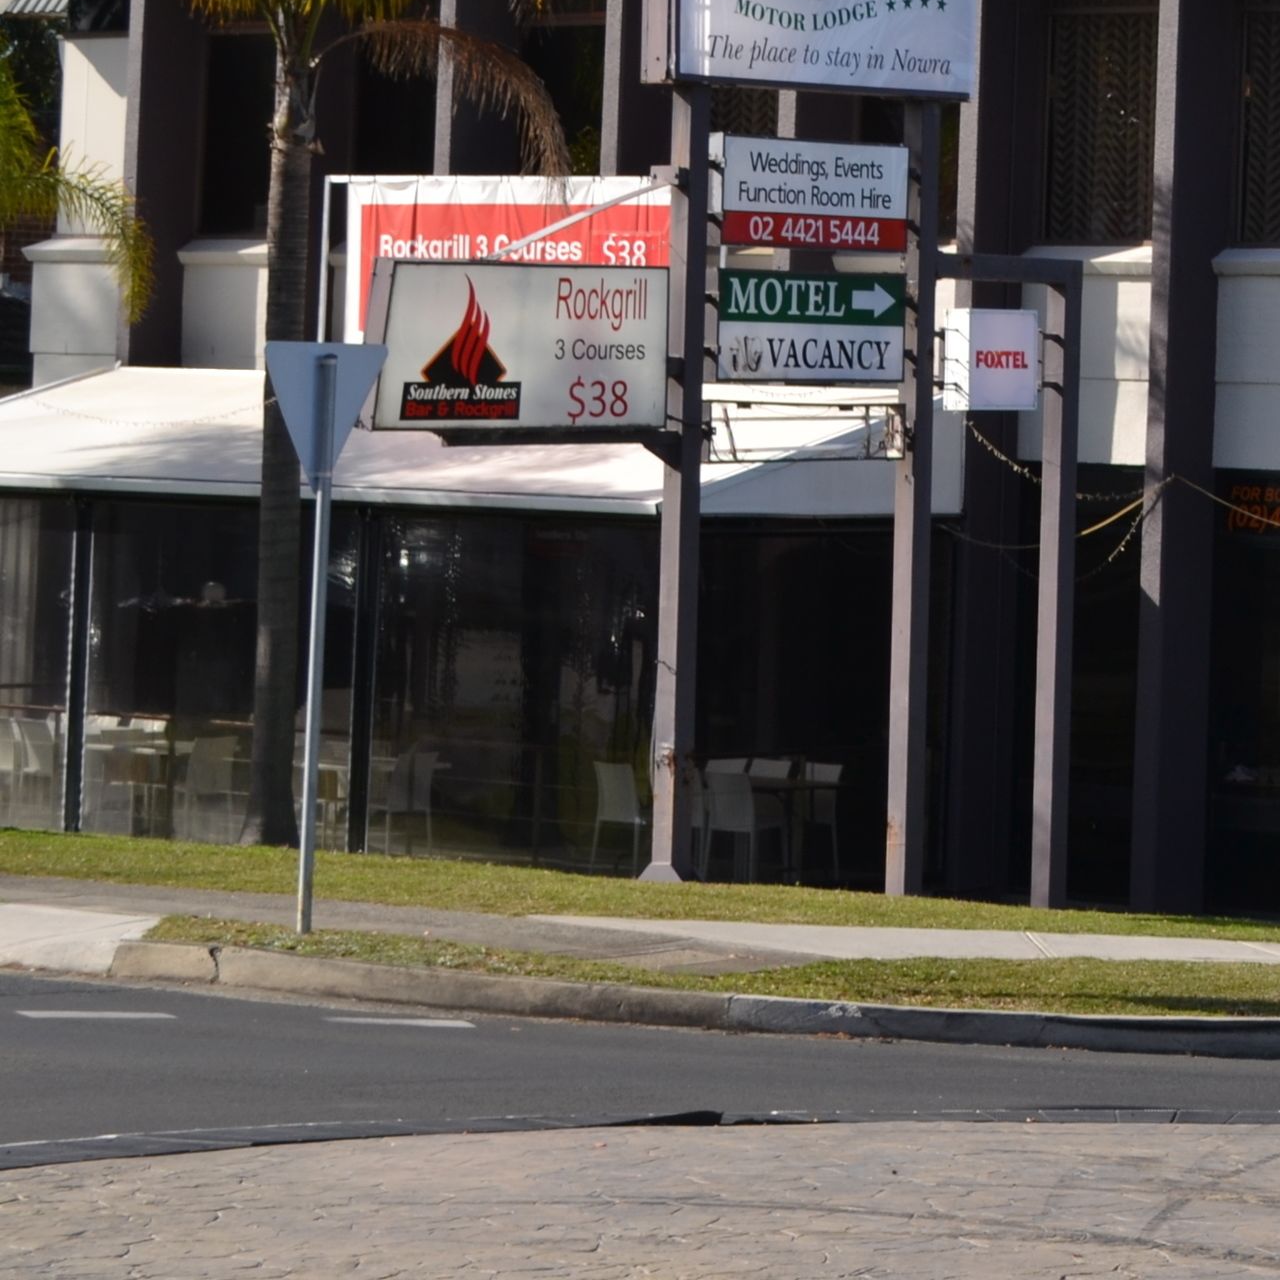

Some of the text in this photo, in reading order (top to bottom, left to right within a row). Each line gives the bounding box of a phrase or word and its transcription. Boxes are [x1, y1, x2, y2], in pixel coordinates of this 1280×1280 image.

[812, 0, 878, 32] LODGE
[708, 34, 951, 77] The place to stay in Nowra
[750, 151, 883, 182] Weddings, Events
[738, 181, 892, 210] Function Room Hire
[750, 215, 880, 246] 02 4421 5444
[476, 234, 488, 258] 3
[602, 232, 647, 266] $38
[556, 276, 648, 332] Rockgrill
[727, 277, 846, 318] MOTEL
[554, 337, 646, 361] 3 Courses
[766, 337, 891, 371] VACANCY
[975, 350, 1028, 369] FOXTEL
[407, 383, 518, 400] Southern Stones
[567, 375, 628, 425] $38
[405, 400, 516, 419] Bar & Rockgrill
[1231, 485, 1261, 501] FOR
